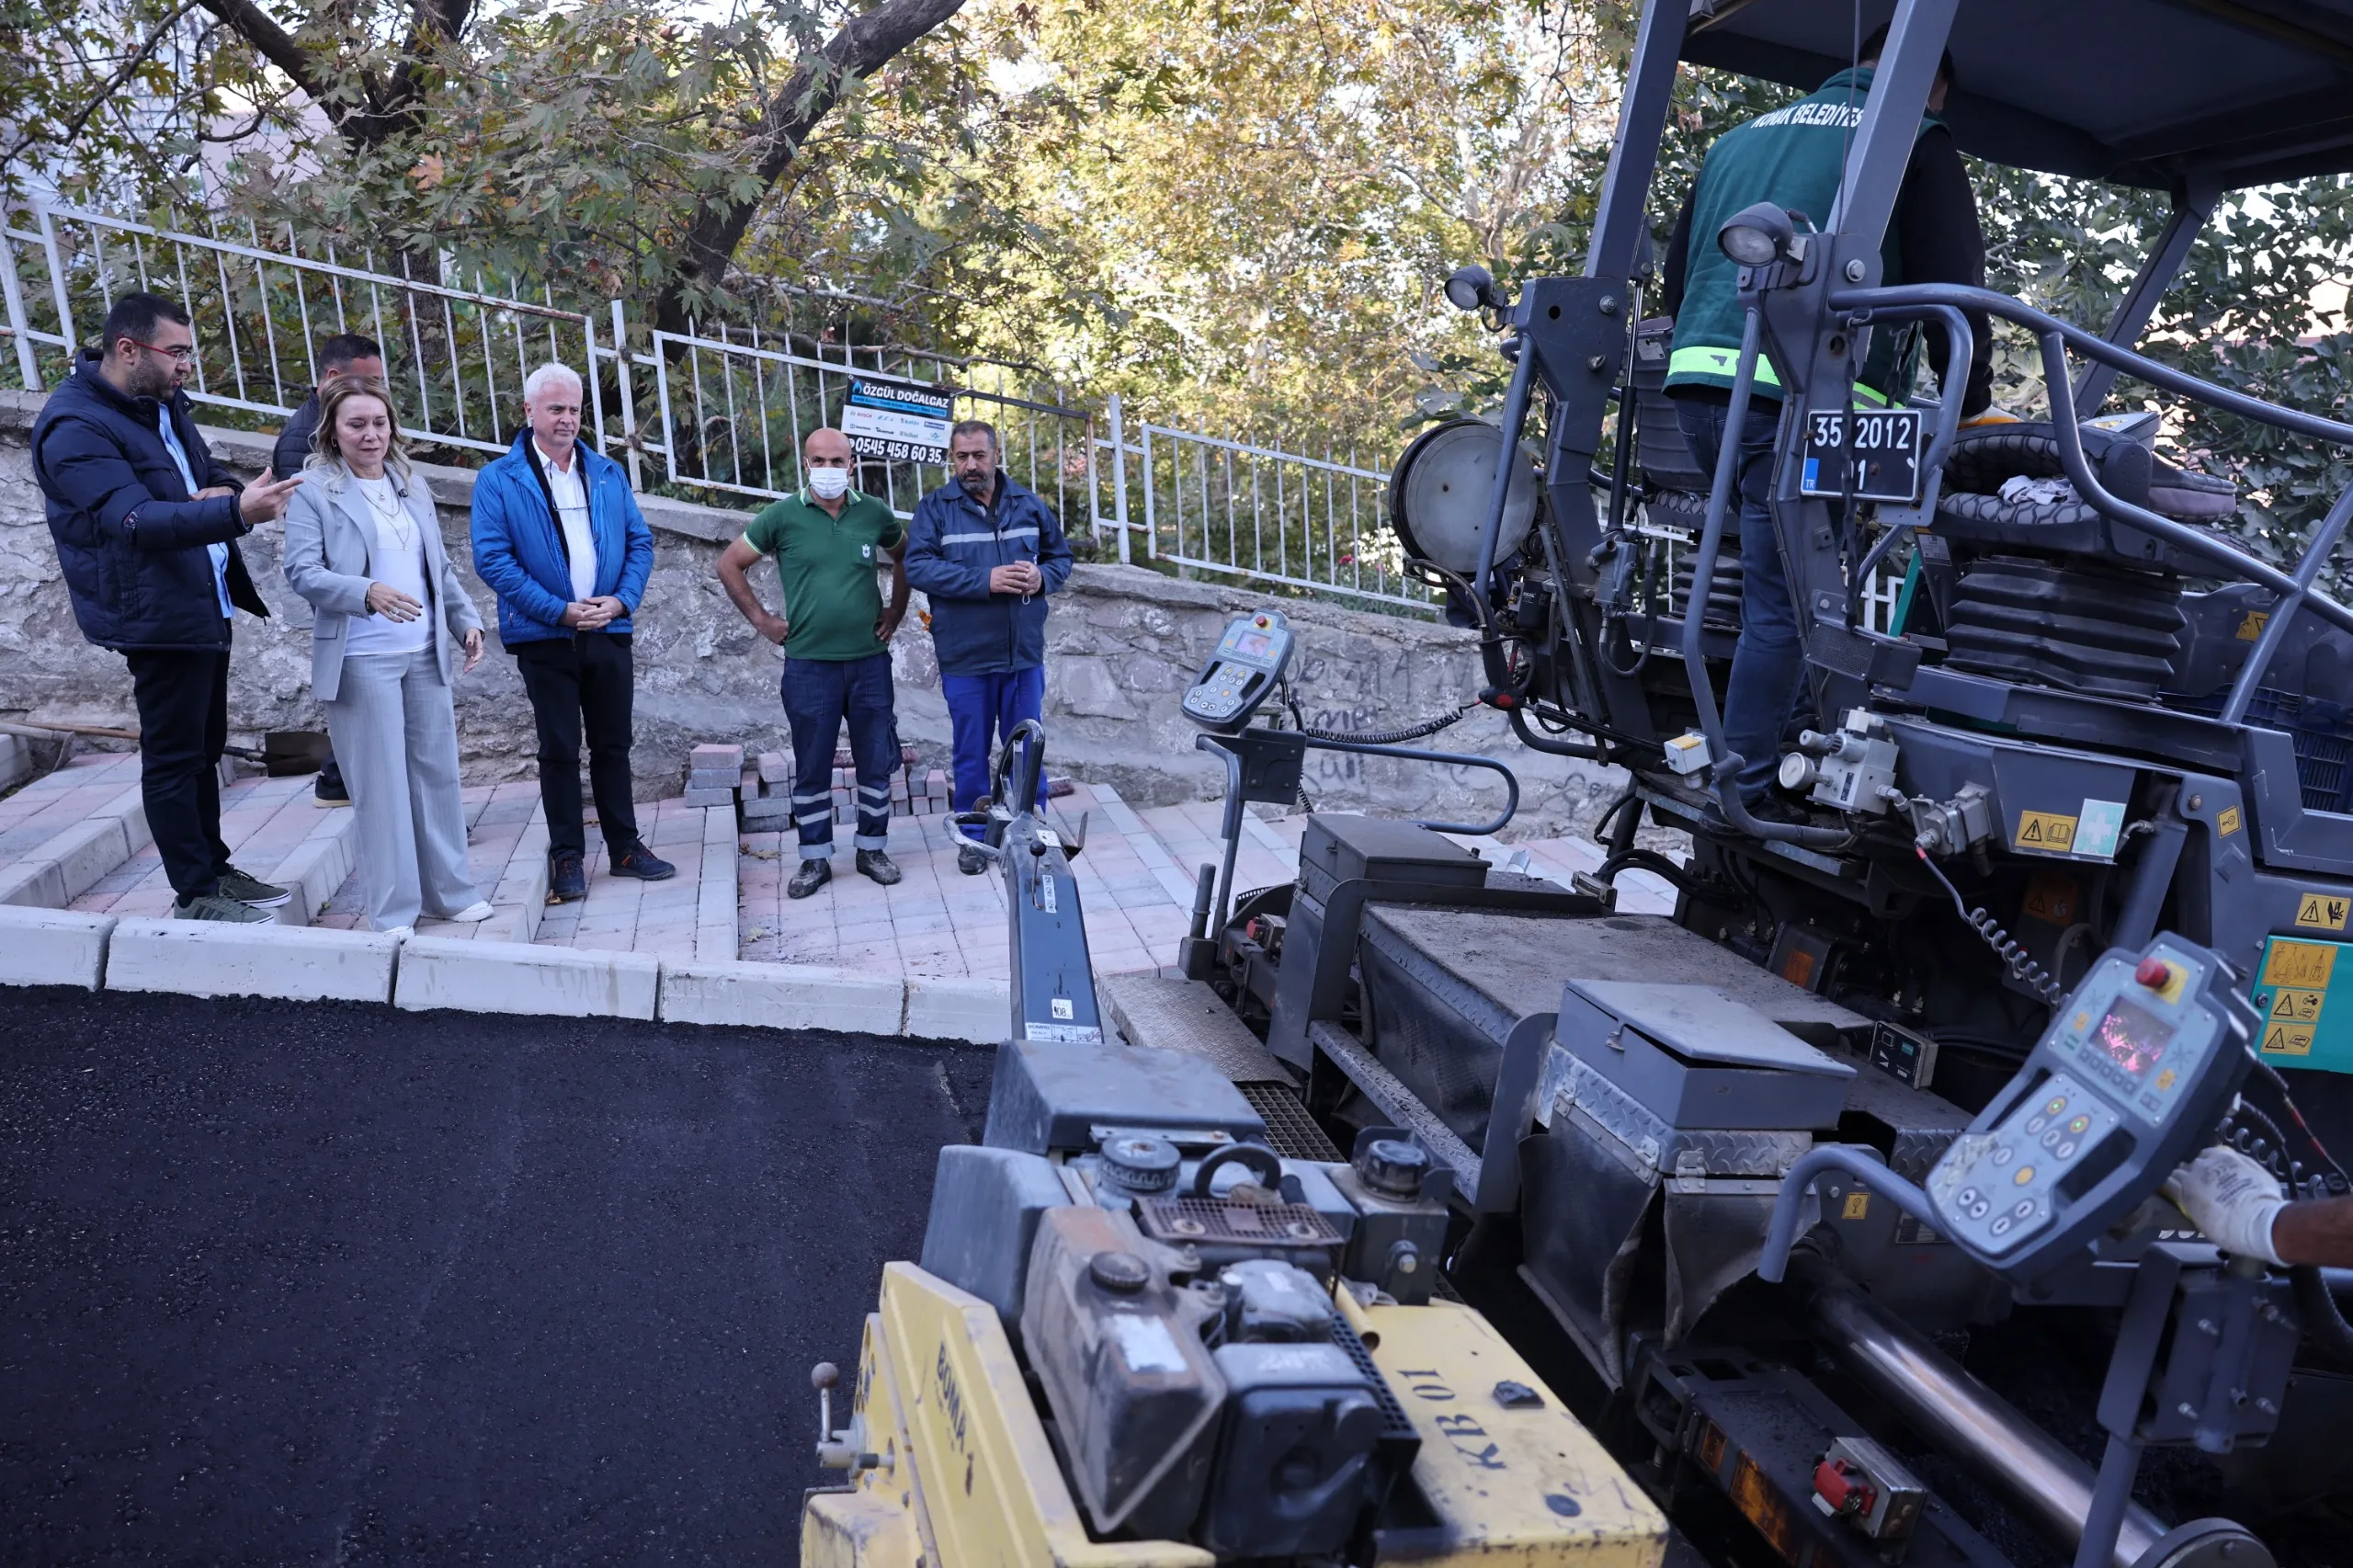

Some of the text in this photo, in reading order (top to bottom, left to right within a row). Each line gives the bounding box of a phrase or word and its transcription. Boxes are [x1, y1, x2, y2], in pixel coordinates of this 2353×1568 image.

[1750, 102, 1865, 129] KONAK BELEDİYES
[863, 382, 895, 400] ÖZGÜL
[897, 391, 949, 408] DOĞALGAZ
[1813, 417, 1912, 449] 35 2012
[855, 437, 943, 464] 0545 458 60 35
[1805, 479, 1815, 489] TR
[1435, 1414, 1507, 1470] KB
